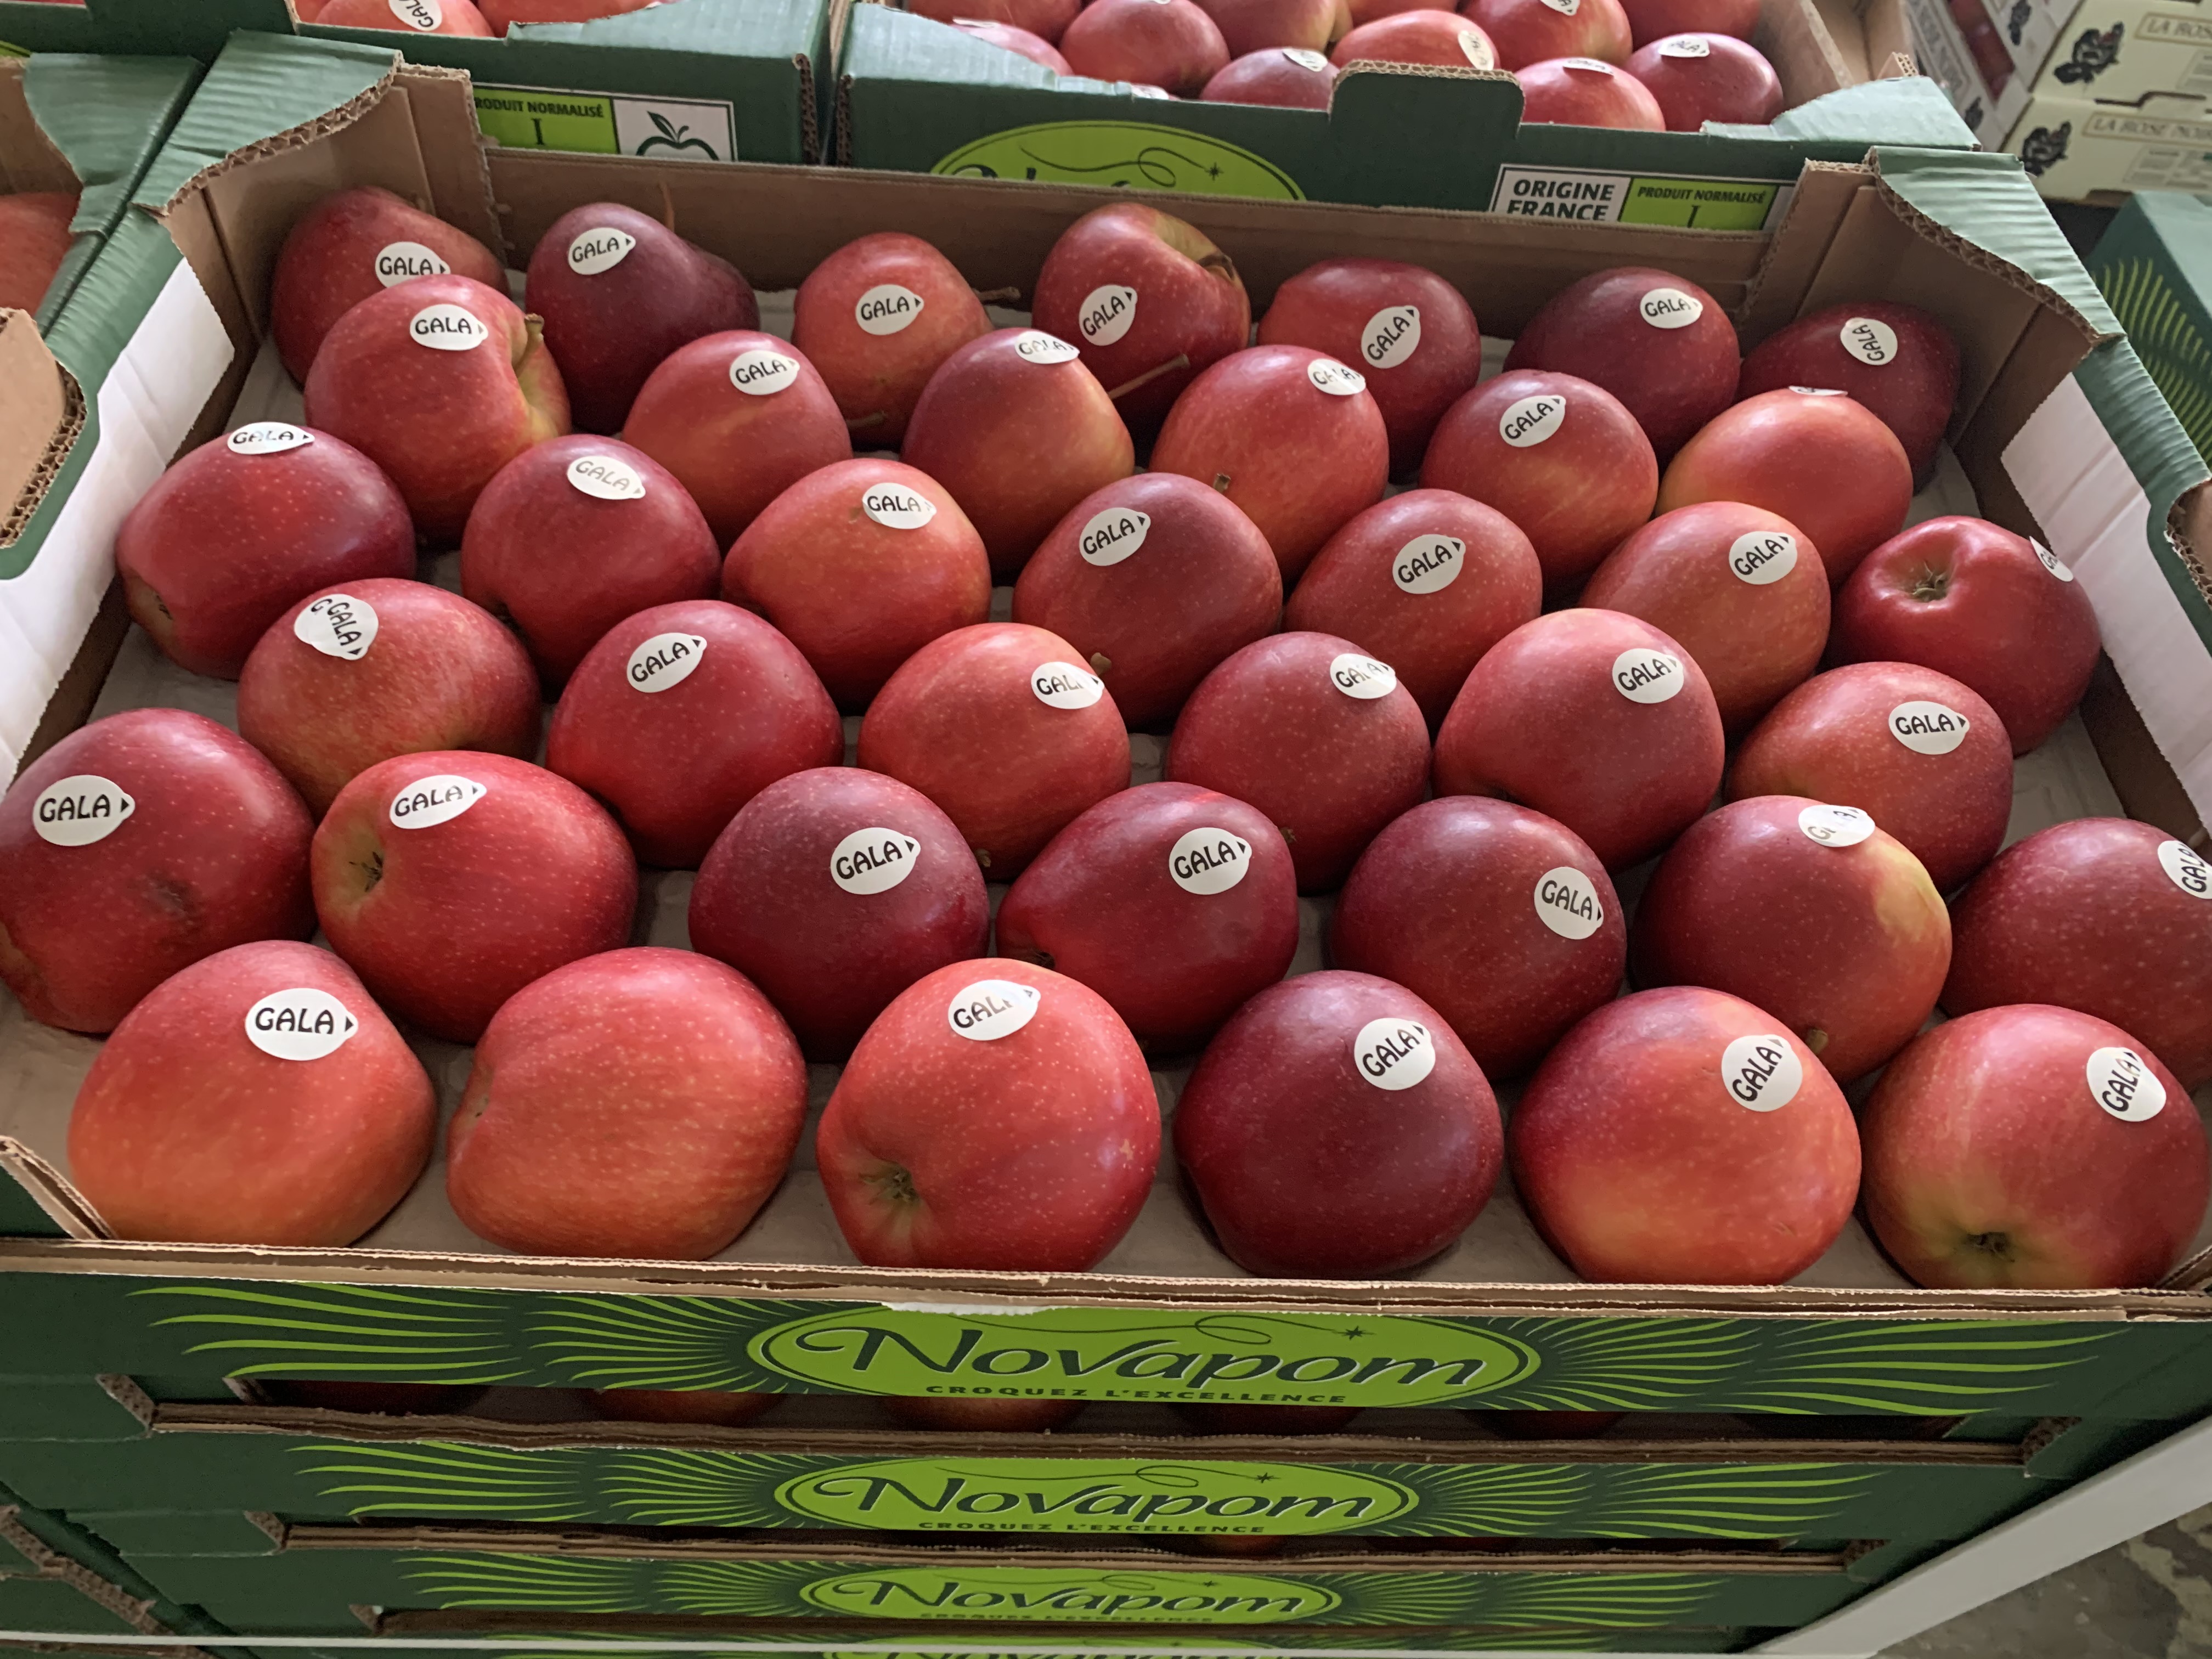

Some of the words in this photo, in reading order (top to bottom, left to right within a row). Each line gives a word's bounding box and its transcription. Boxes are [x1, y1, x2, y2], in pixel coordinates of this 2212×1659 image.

[402, 0, 434, 27] GAL
[527, 101, 604, 118] NORMALISÉ
[1513, 178, 1616, 201] ORIGINE
[1637, 186, 1694, 200] PRODUIT
[1694, 189, 1766, 204] NORMALISÉ
[1506, 199, 1609, 221] FRANCE
[379, 256, 433, 275] GALA
[572, 237, 619, 263] GALA
[861, 296, 910, 320] GALA
[1082, 296, 1125, 336] GALA
[1644, 298, 1692, 317] GALA
[415, 317, 472, 335] GALA
[1367, 315, 1410, 361] GALA
[1852, 324, 1885, 362] GALA
[735, 359, 788, 383] GALA
[1504, 403, 1554, 439] GALA
[233, 430, 294, 444] GALA
[575, 461, 630, 490] GALA
[867, 495, 921, 512] GALA
[1083, 518, 1136, 555] GALA
[1397, 544, 1453, 583] GALA
[1734, 539, 1784, 575] GALA
[327, 602, 362, 646] GALA
[631, 642, 690, 682] GALA
[1618, 658, 1672, 691] GALA
[1036, 675, 1085, 695] GAL
[1895, 713, 1955, 735] GALA
[39, 794, 110, 822] GALA
[394, 785, 463, 816] GALA
[836, 840, 903, 879] GALA
[1174, 840, 1237, 879] GALA
[1542, 879, 1592, 921] GALA
[255, 1007, 334, 1035] GALA
[953, 996, 1014, 1028] GAL
[1362, 1029, 1420, 1076] GALA
[1732, 1046, 1783, 1102] GALA
[2102, 1058, 2141, 1112] GALA
[795, 1326, 1487, 1390] Novapom
[926, 1385, 1088, 1397] CROQUEZ
[1105, 1389, 1346, 1403] L'EXCELLENCE
[813, 1476, 1375, 1524] Novapom
[918, 1522, 1053, 1531] CROQUEZ
[1066, 1523, 1265, 1533] L'EXCELLENCE
[832, 1579, 1306, 1616] Novapom
